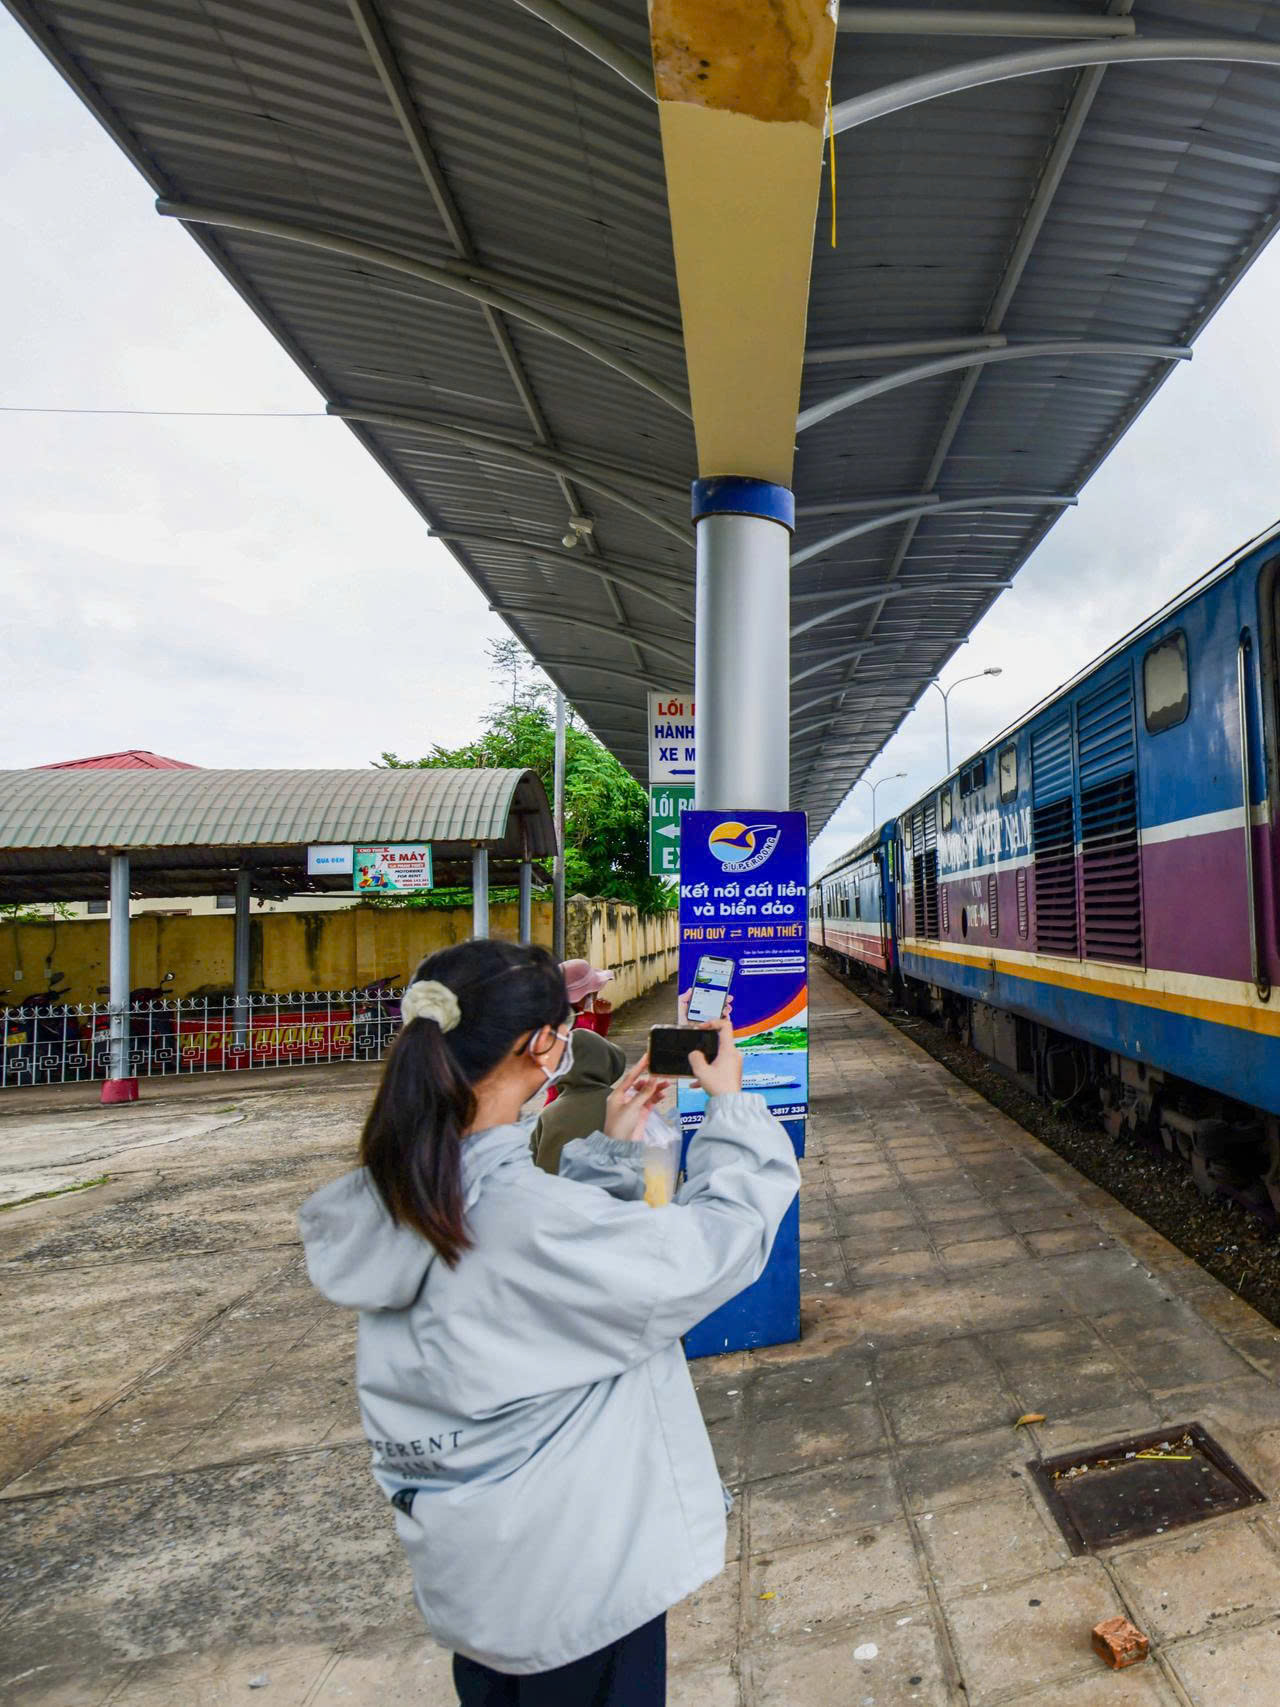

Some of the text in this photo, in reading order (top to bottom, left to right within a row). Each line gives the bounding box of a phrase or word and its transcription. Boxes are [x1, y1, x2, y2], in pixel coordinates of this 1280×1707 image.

[657, 698, 683, 716] LỐI
[654, 722, 695, 739] HÀNH
[659, 747, 678, 761] XE
[652, 791, 674, 817] LỐI
[399, 851, 425, 861] MÁY
[723, 837, 775, 870] SUPERDONG
[681, 880, 806, 898] Kết nối đất liền
[693, 898, 794, 916] và biển đảo
[706, 925, 726, 939] QUÝ
[748, 926, 774, 938] PHAN
[776, 922, 803, 937] THIẾT
[772, 1107, 789, 1115] 3817
[791, 1106, 806, 1114] 338
